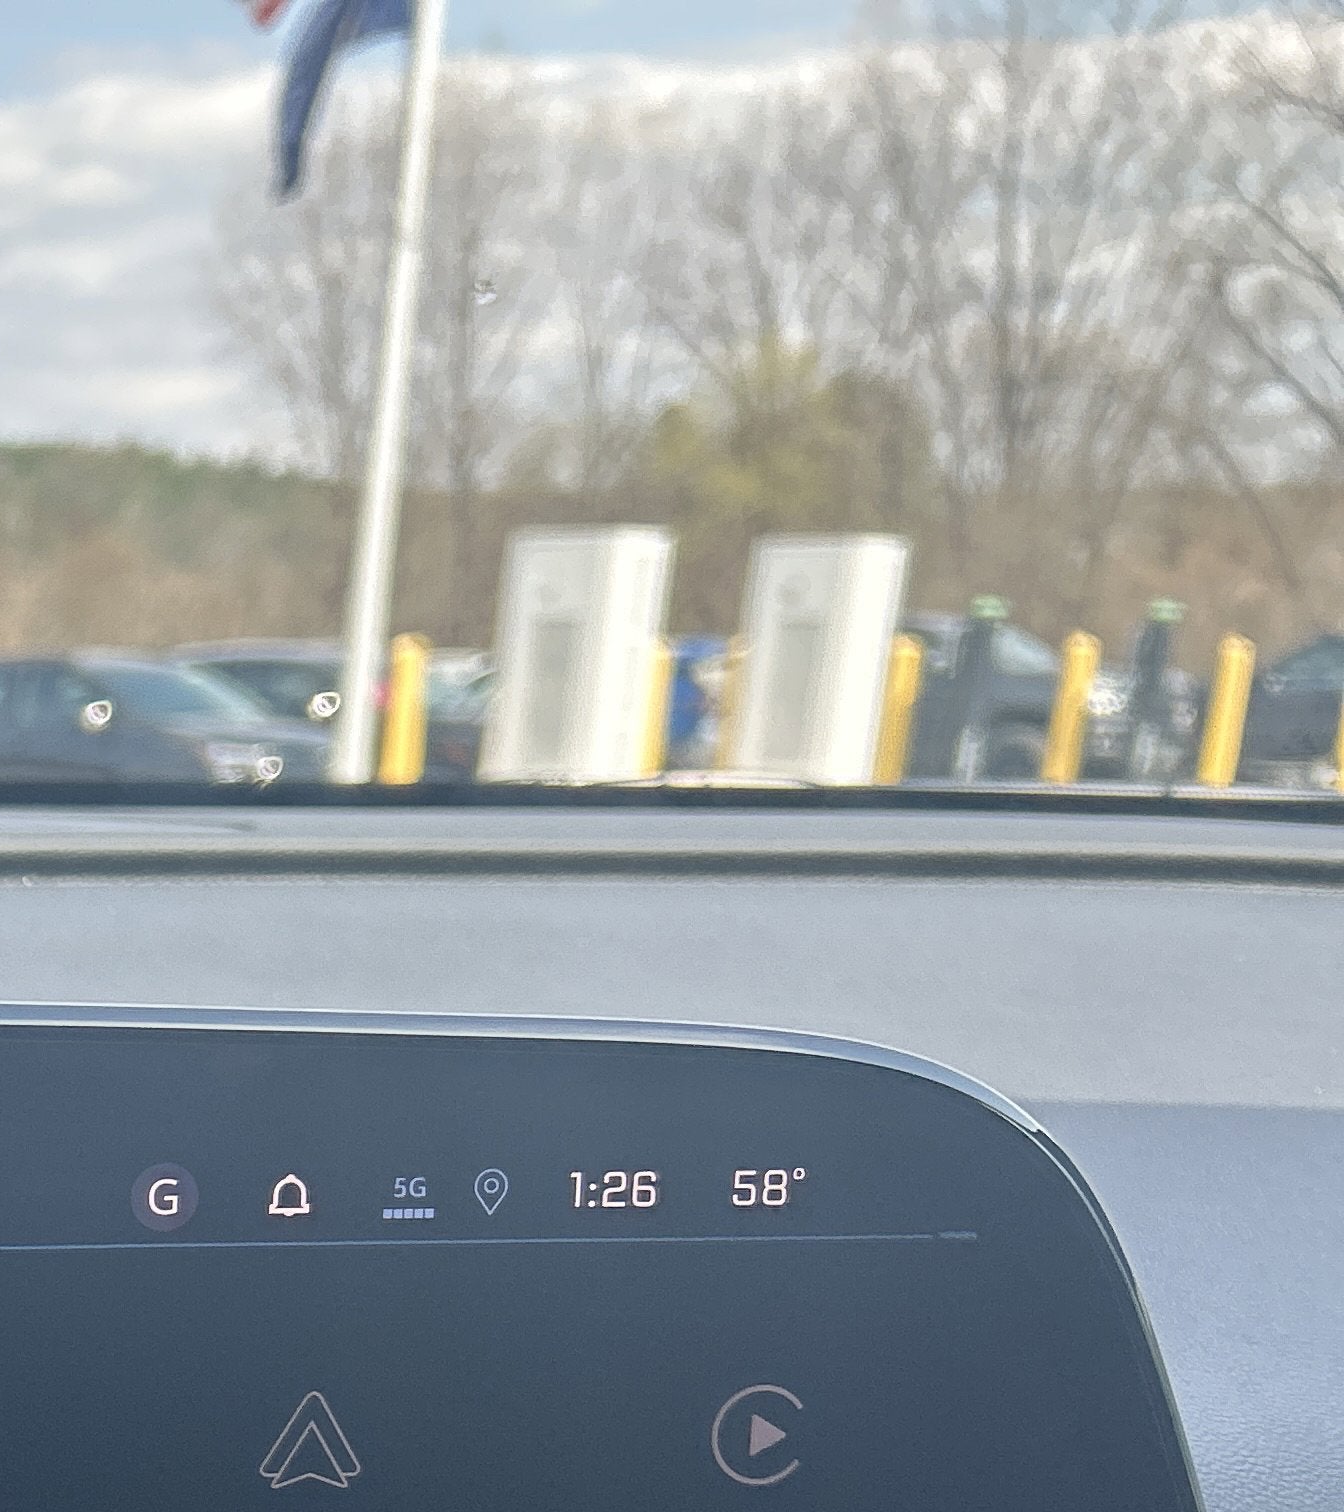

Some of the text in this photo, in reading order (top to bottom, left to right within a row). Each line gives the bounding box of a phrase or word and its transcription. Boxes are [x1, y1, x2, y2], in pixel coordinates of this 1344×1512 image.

[148, 1178, 179, 1216] G
[393, 1176, 427, 1199] 5G
[570, 1170, 657, 1208] 1:26
[732, 1167, 806, 1206] 58°
